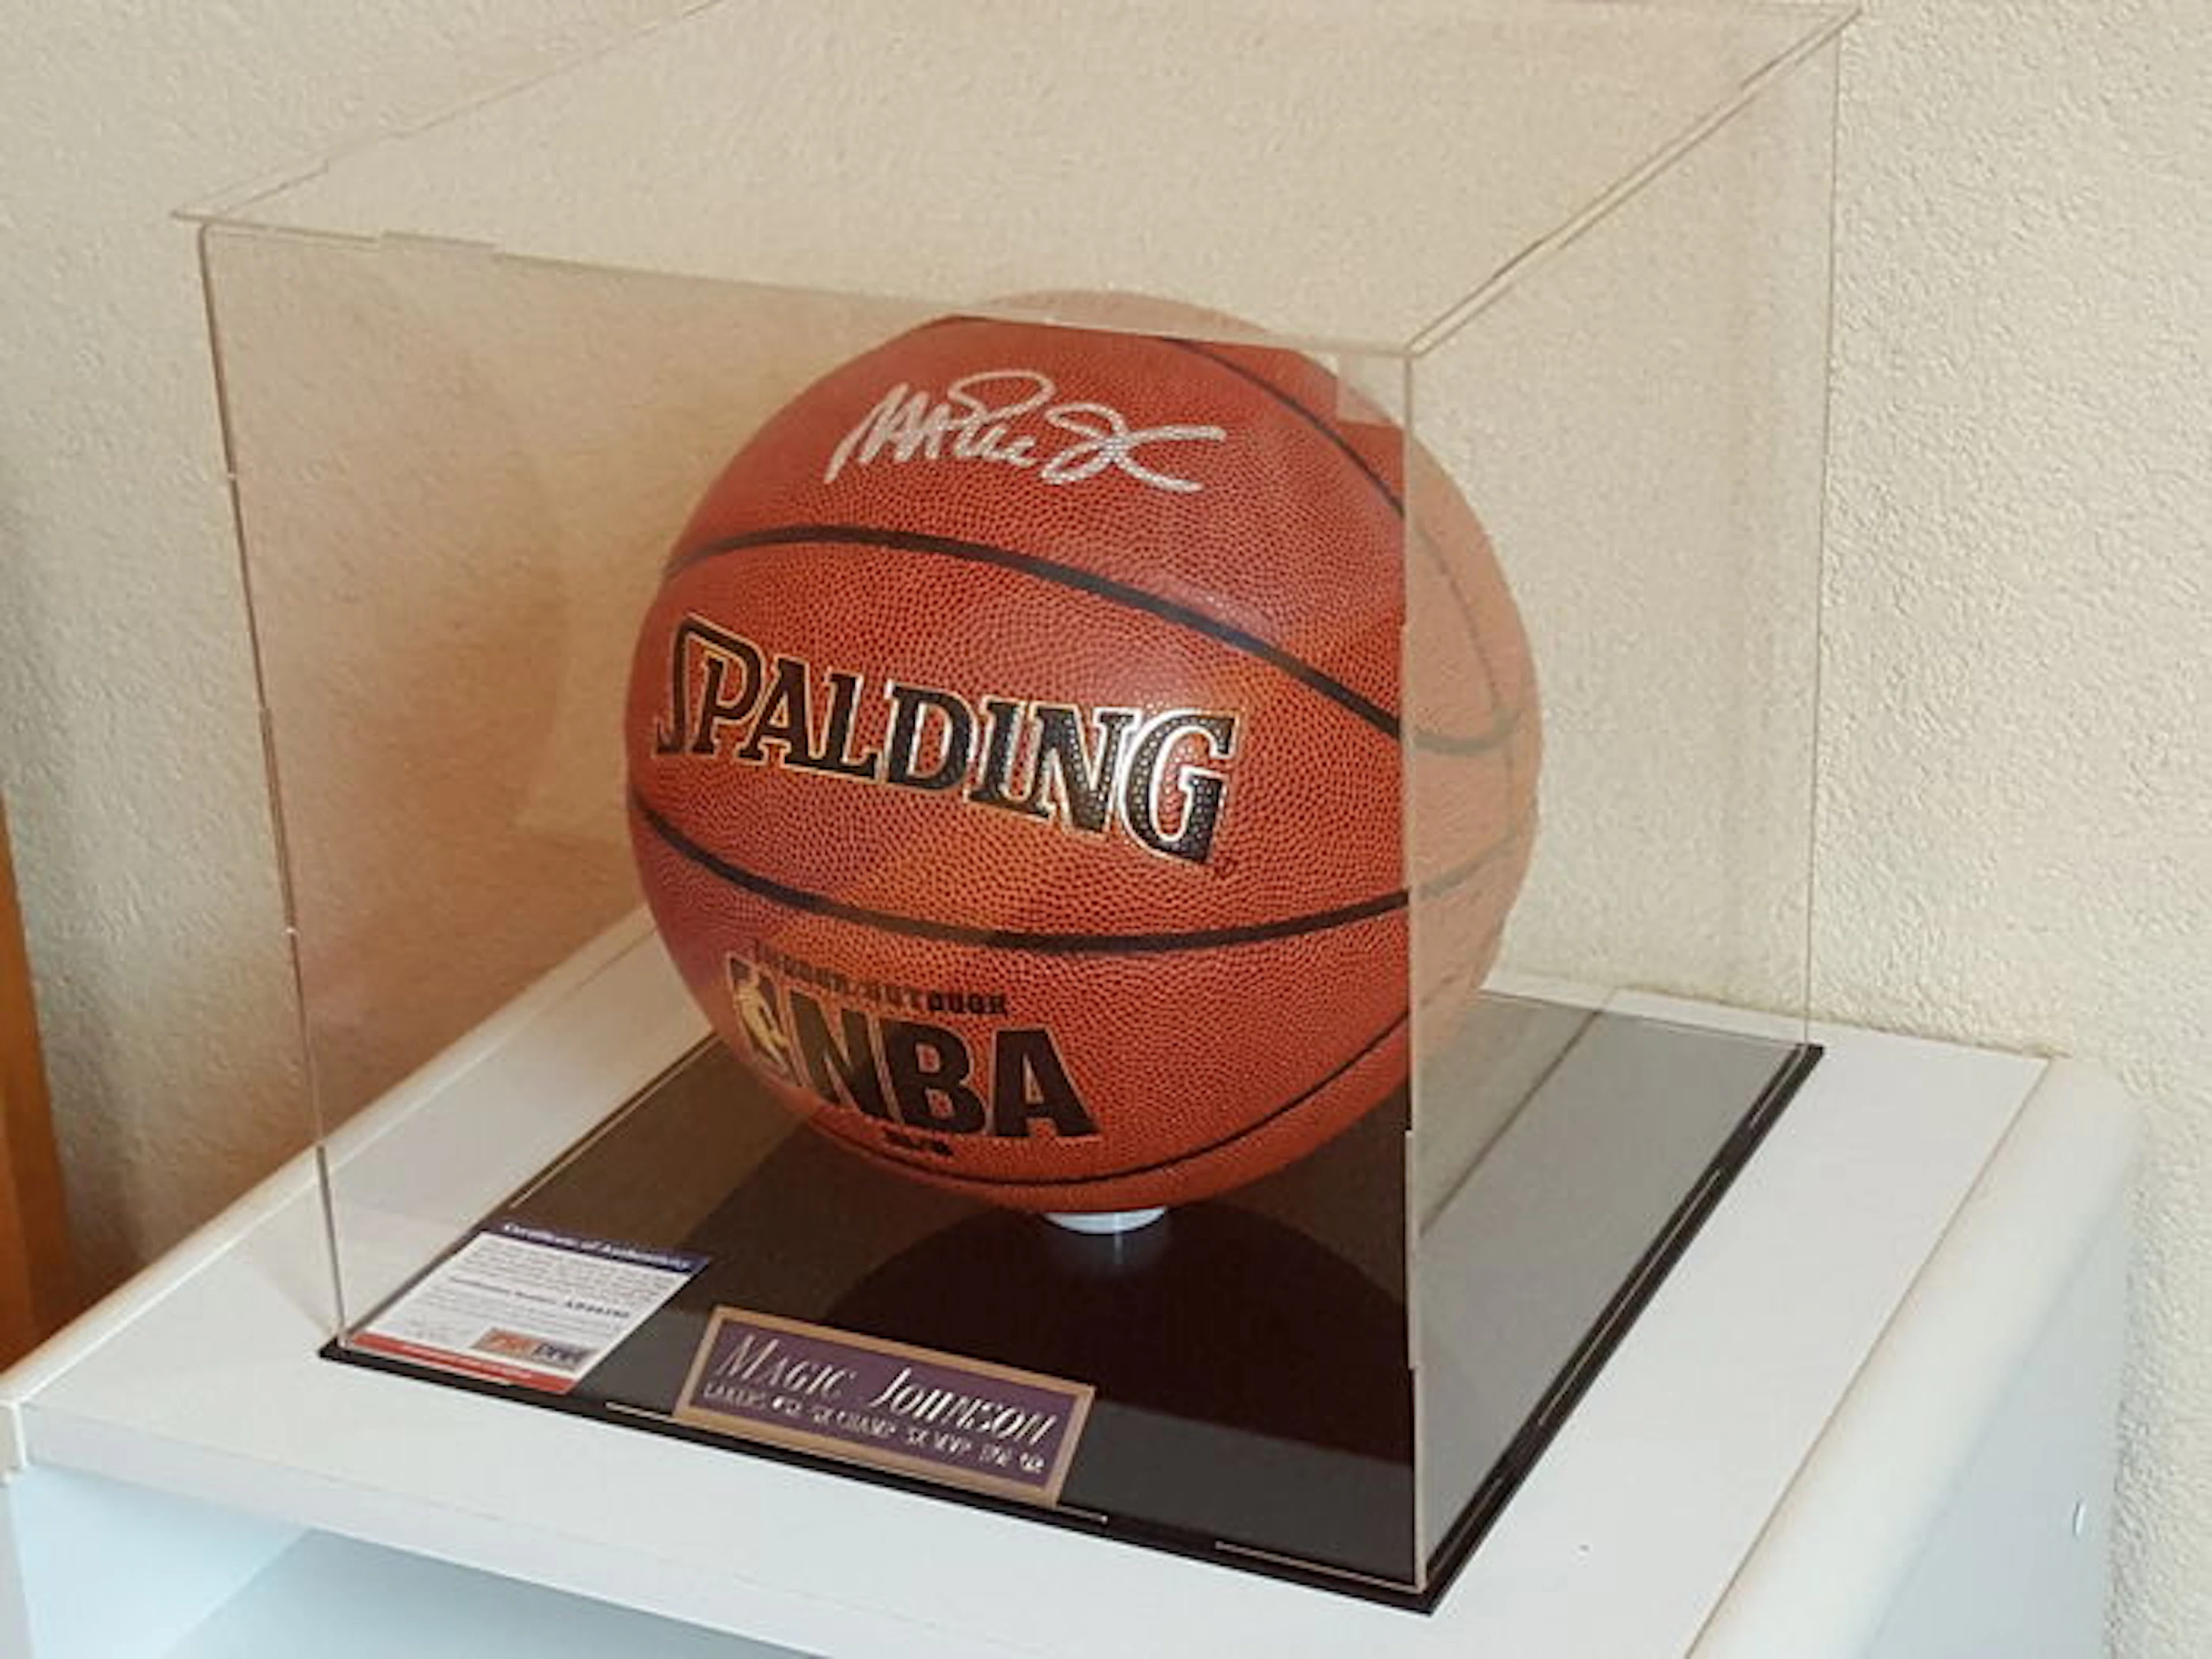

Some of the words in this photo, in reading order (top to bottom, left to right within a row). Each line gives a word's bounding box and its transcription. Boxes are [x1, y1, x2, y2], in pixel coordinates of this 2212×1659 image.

[654, 613, 1243, 865] SPALDING
[788, 988, 1101, 1138] NBA
[869, 1367, 1058, 1445] JOHNSON
